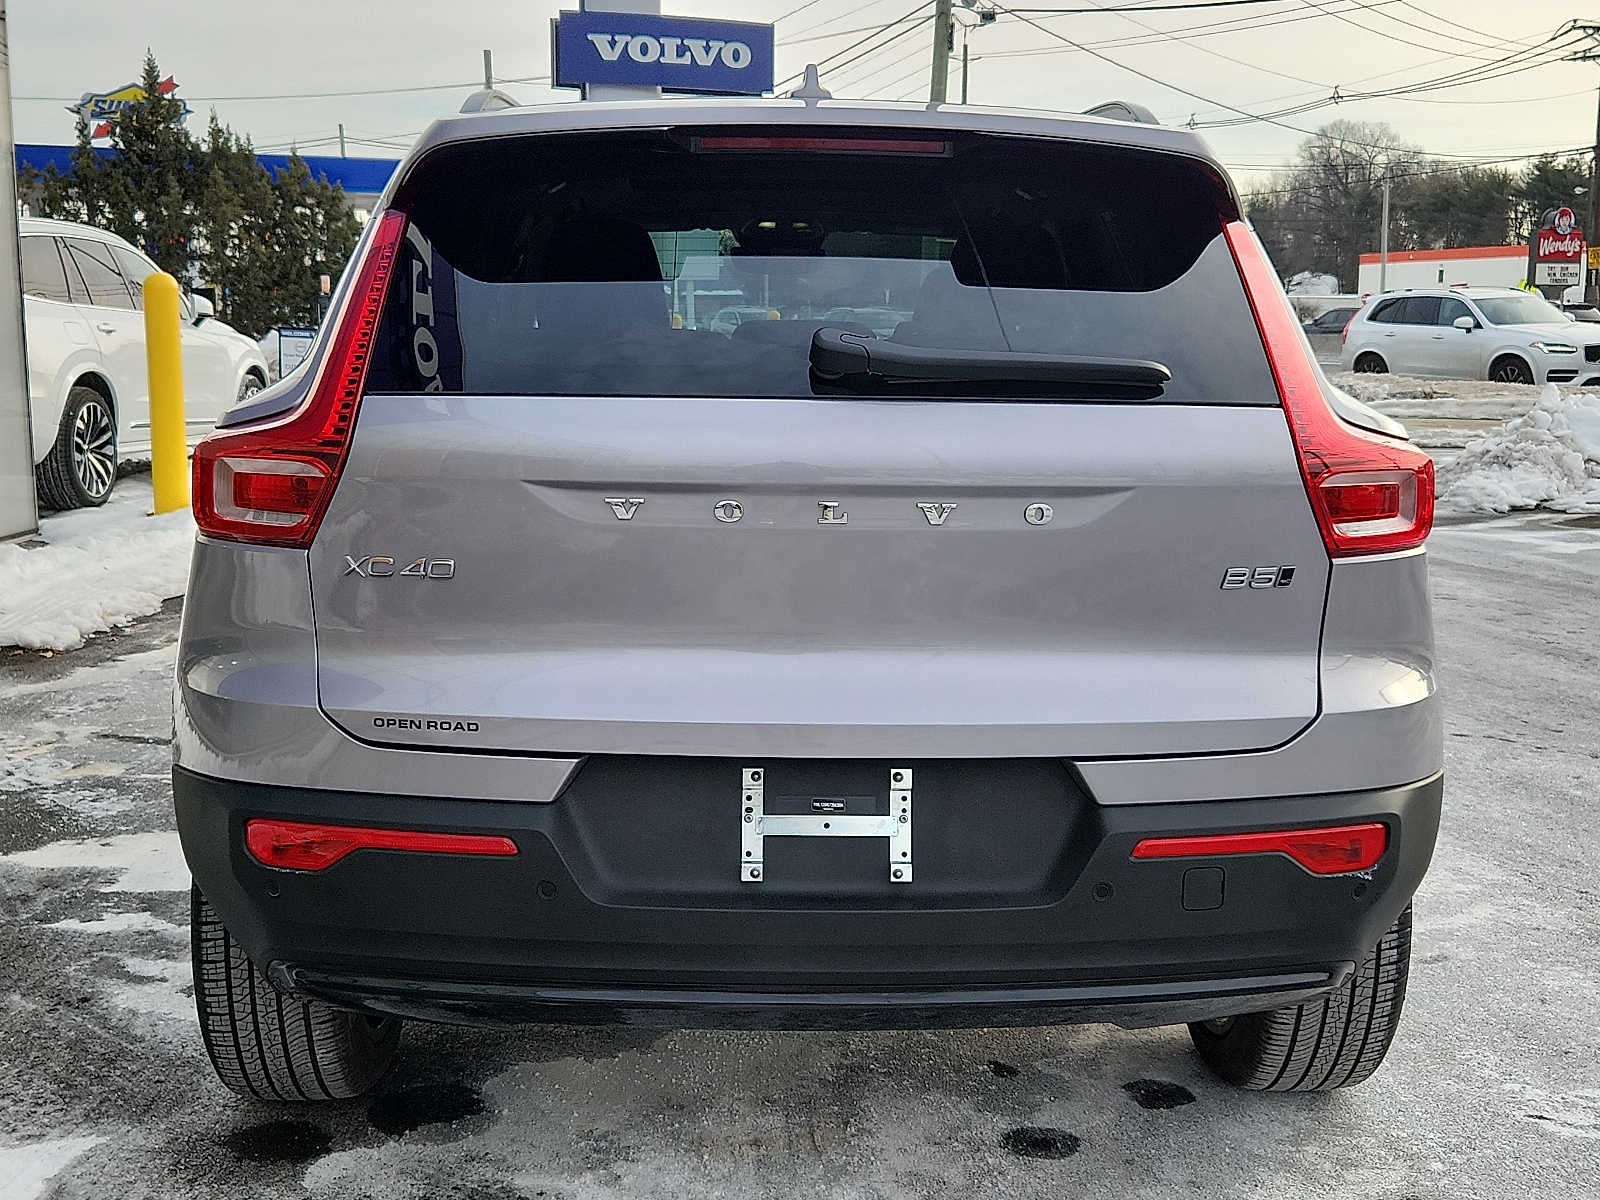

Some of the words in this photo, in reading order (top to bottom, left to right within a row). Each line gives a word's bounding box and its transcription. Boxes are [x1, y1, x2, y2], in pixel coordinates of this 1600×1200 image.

[587, 34, 752, 69] VOLVO
[1539, 235, 1581, 257] Wendy's
[604, 496, 1055, 526] VOLVO
[373, 717, 422, 730] OPEN
[426, 720, 480, 732] ROAD
